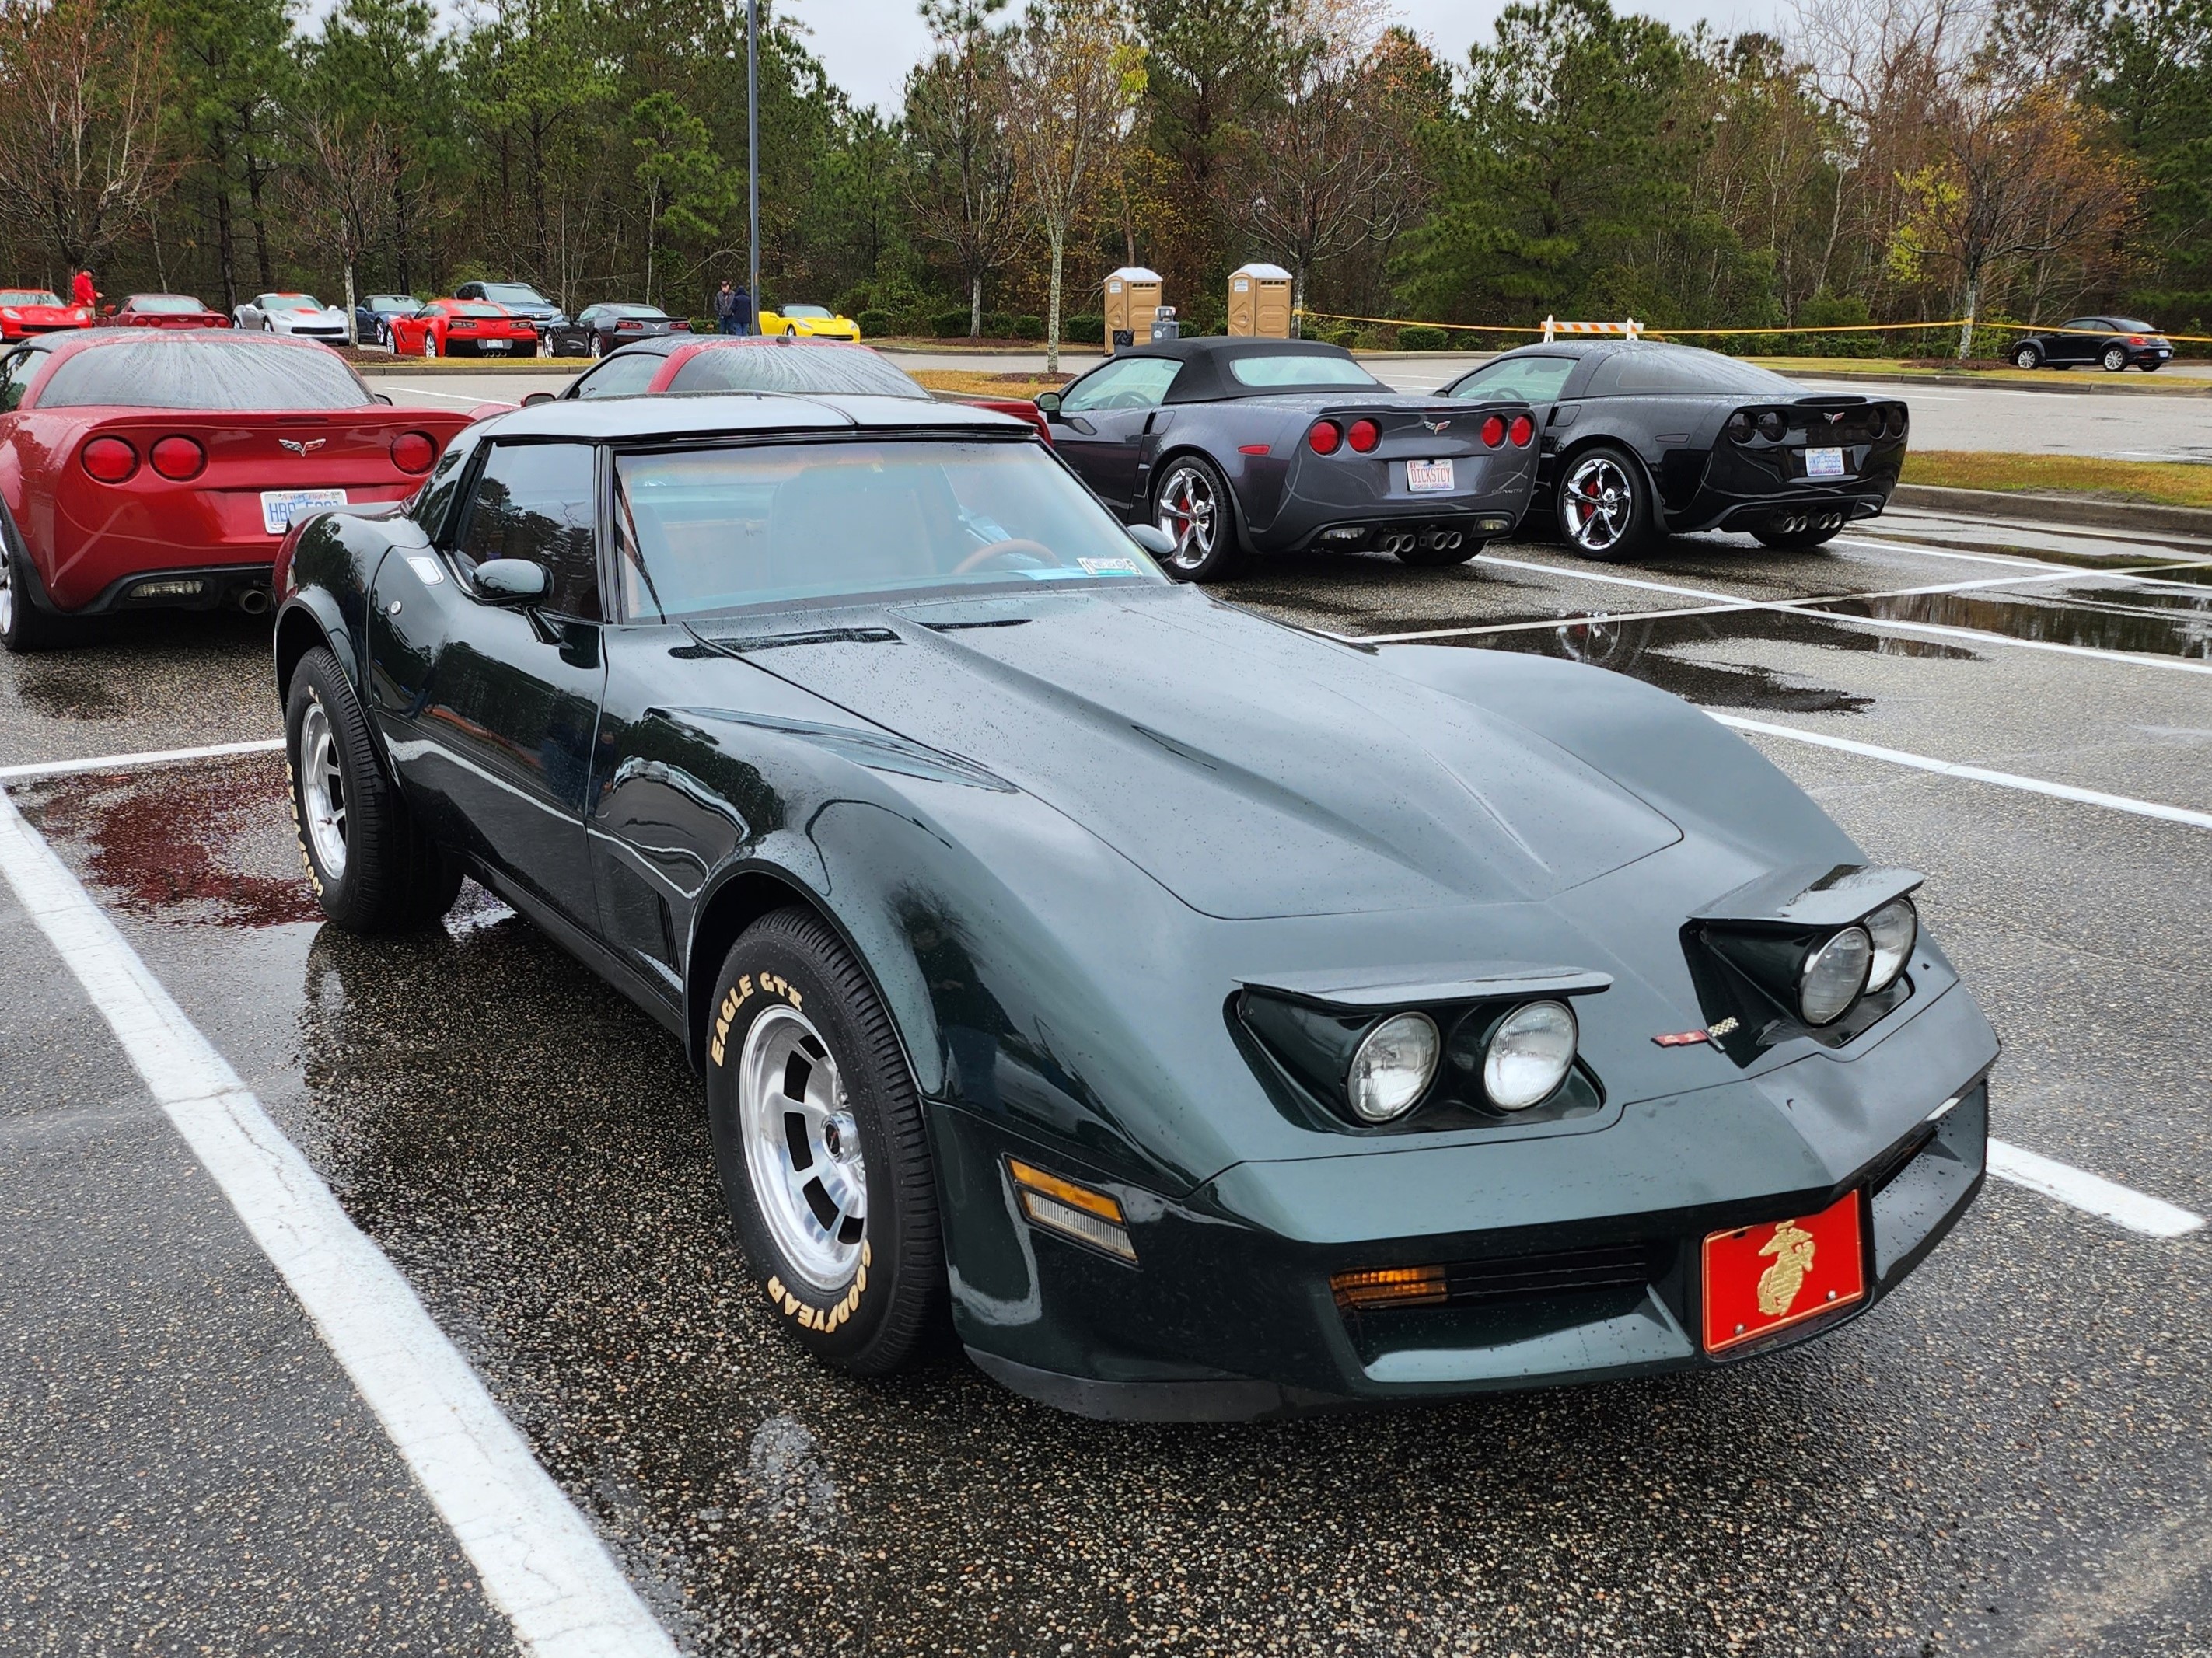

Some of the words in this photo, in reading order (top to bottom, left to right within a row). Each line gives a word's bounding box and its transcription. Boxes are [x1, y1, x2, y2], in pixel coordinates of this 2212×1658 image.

[1410, 468, 1451, 483] DICKSTOY
[711, 973, 754, 1067] EAGLE
[767, 1237, 872, 1334] GOODYEAR
